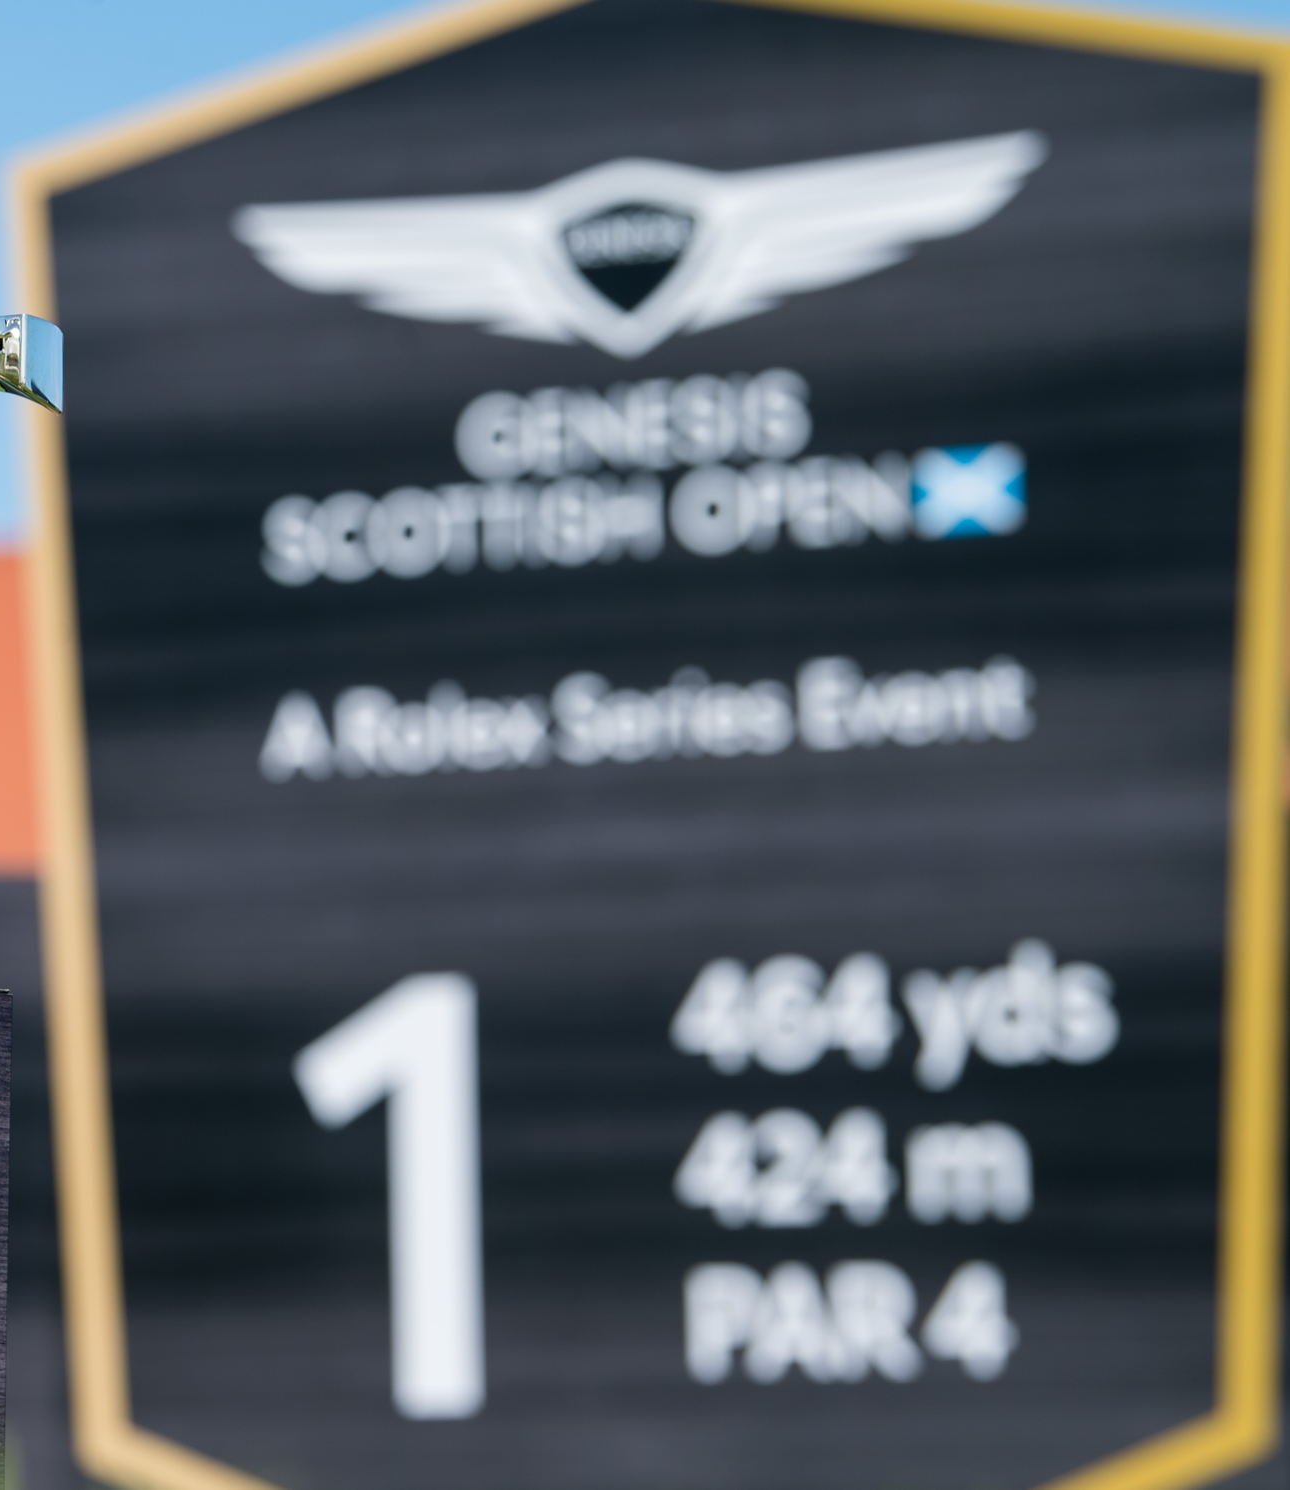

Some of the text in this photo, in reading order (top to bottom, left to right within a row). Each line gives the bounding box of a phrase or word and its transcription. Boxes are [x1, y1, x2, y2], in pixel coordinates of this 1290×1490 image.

[456, 368, 811, 482] GENESIS
[262, 450, 911, 587] SCOTTISH OPEN
[259, 654, 1036, 783] A Rolex Series Event
[670, 938, 1119, 1091] 464 yds
[292, 971, 485, 1419] 1
[674, 1106, 1033, 1227] 424 m
[683, 1259, 1018, 1384] PAR 4
